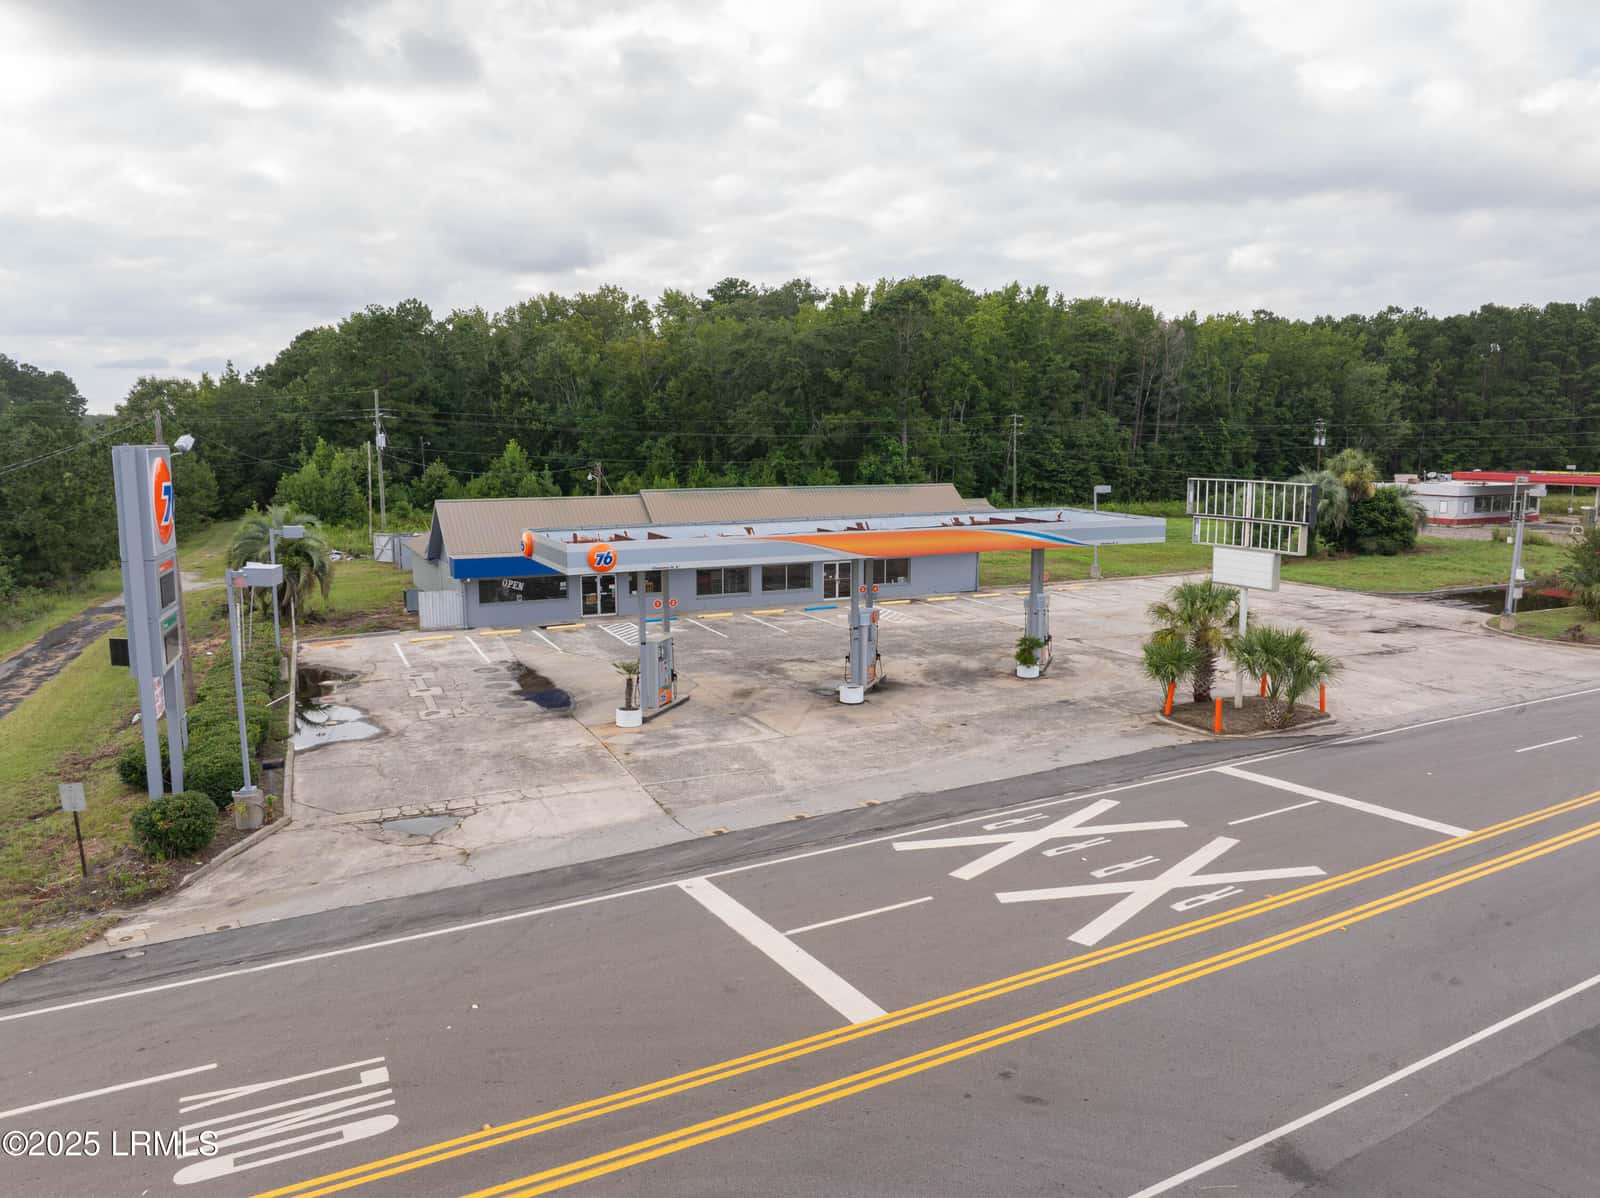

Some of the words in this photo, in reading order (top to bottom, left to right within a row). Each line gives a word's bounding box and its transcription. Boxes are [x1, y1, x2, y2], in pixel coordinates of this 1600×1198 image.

[502, 577, 525, 592] OPEN
[595, 550, 614, 566] 76
[892, 798, 1188, 881] X
[994, 836, 1328, 947] X
[173, 1056, 400, 1186] ONLY
